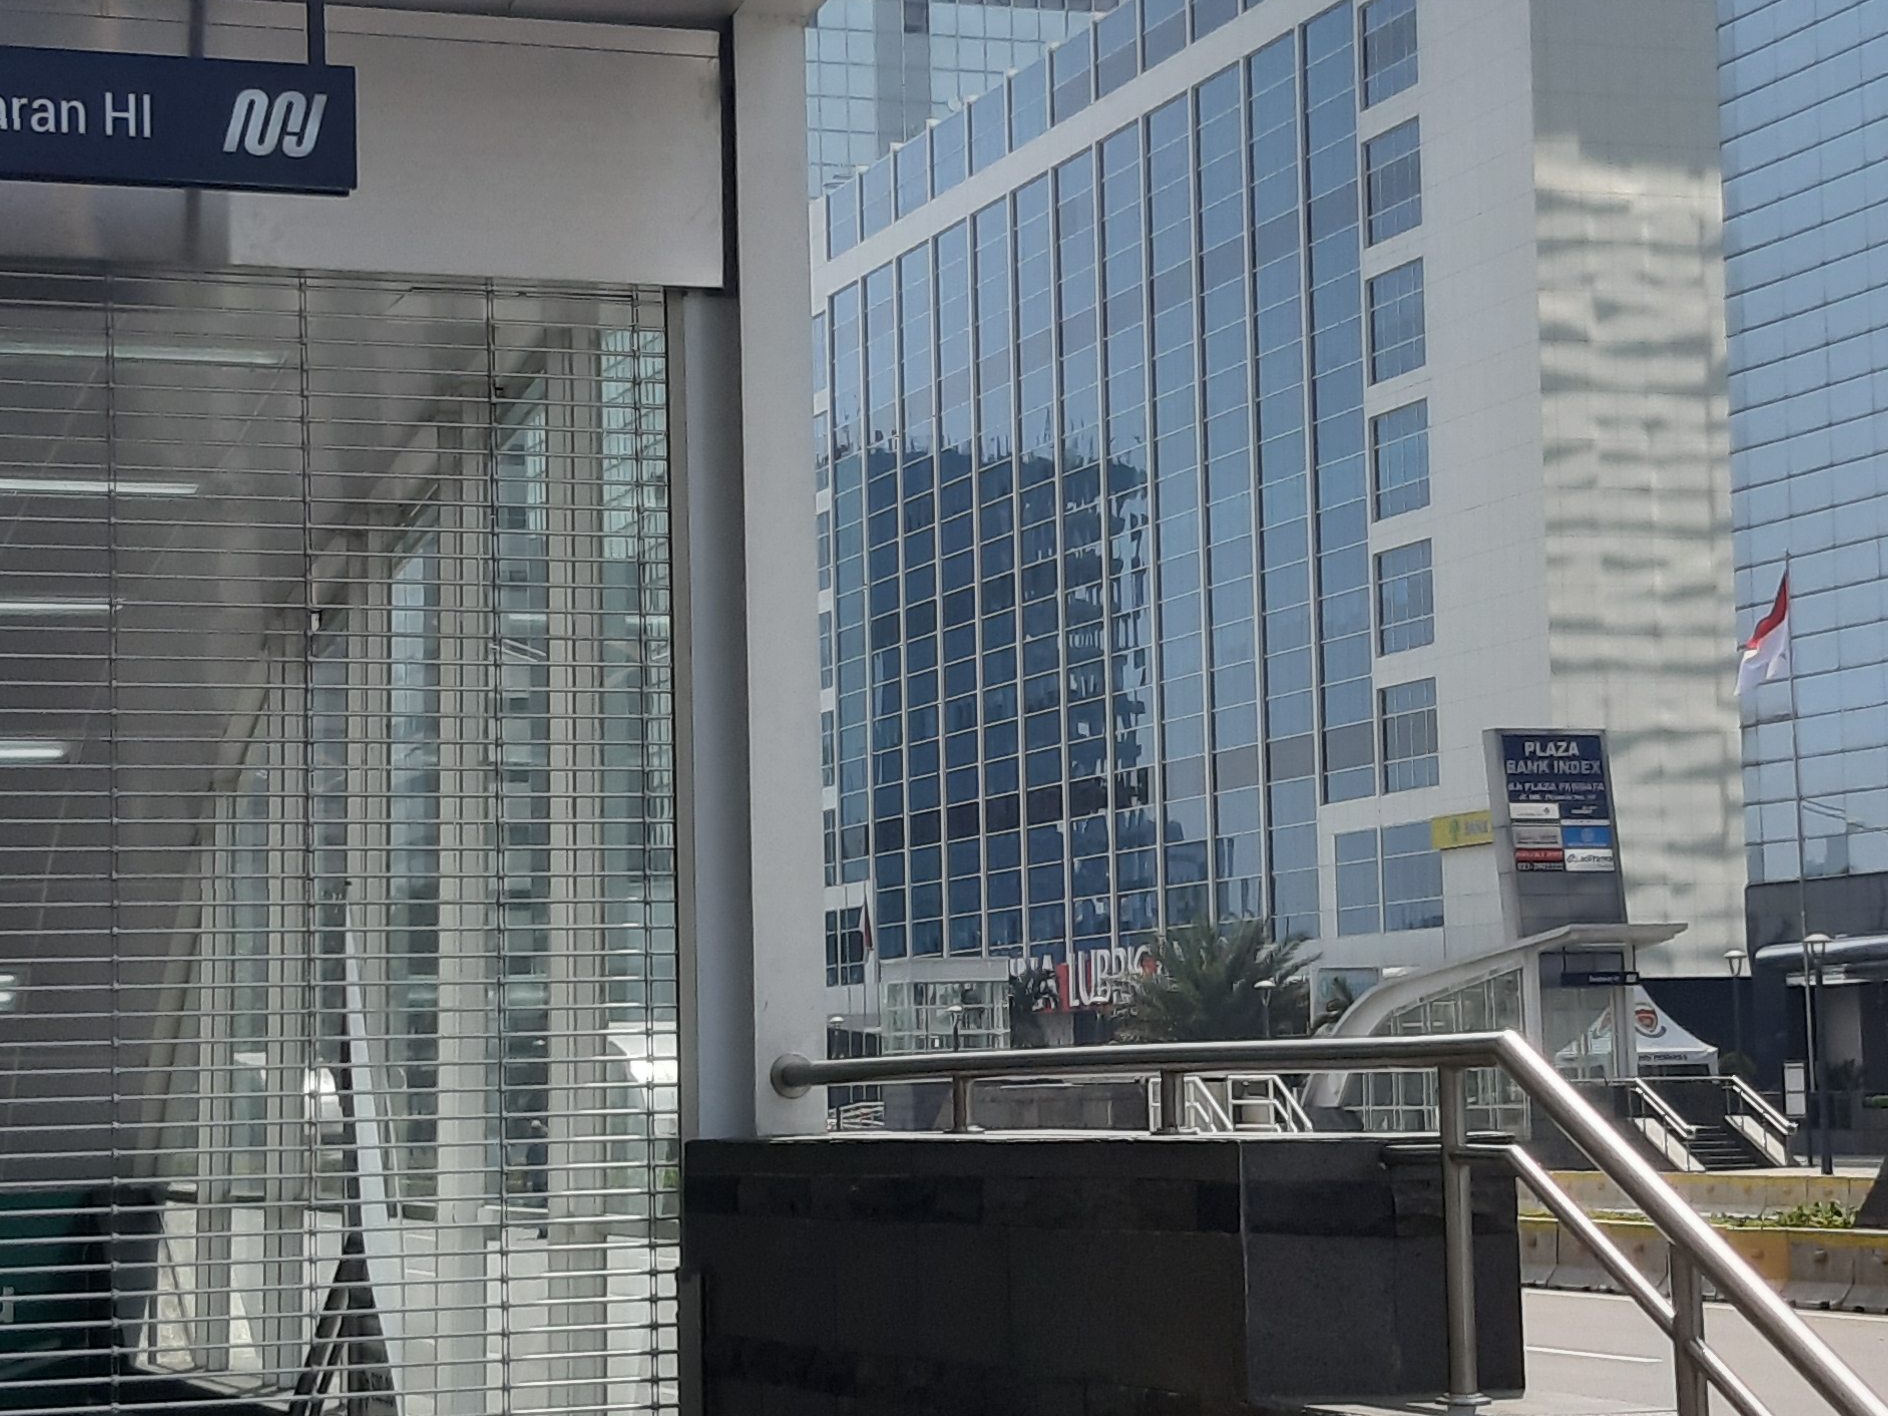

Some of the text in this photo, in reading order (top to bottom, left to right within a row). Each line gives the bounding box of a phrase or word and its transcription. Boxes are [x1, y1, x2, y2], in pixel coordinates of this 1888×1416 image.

[104, 91, 152, 139] HI
[1524, 741, 1580, 757] PLAZA
[1506, 759, 1602, 775] BANK INDEX
